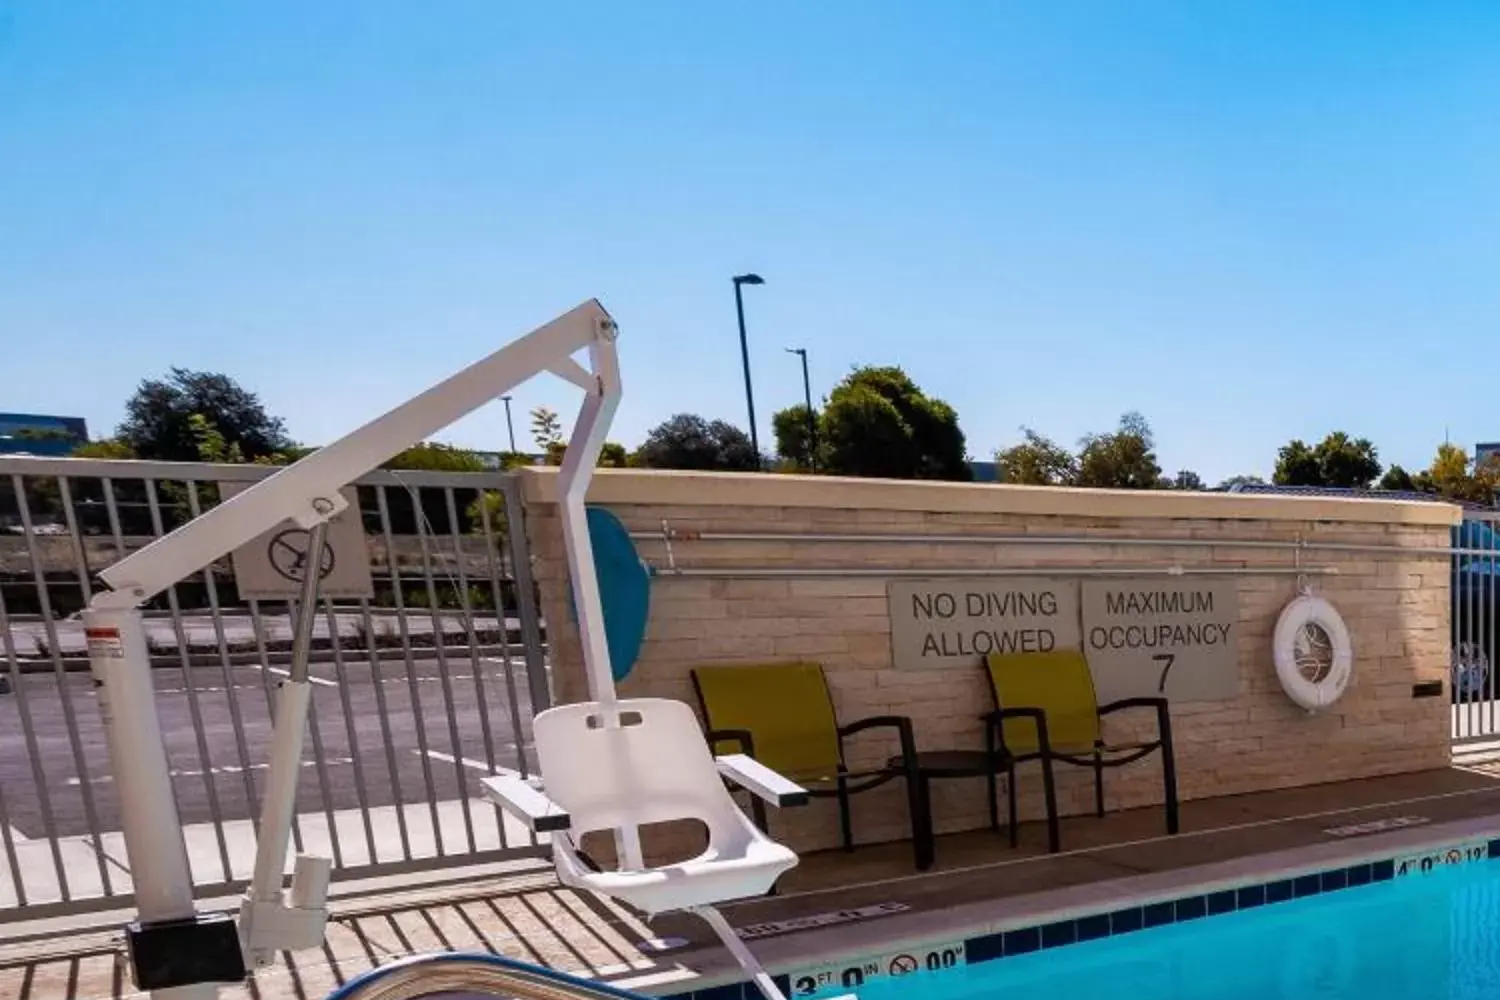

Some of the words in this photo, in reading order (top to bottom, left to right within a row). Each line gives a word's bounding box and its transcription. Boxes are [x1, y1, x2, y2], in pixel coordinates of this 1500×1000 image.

[912, 592, 957, 619] NO
[965, 591, 1058, 617] DIVING
[1105, 591, 1214, 615] MAXIMUM
[921, 629, 1055, 657] ALLOWED
[1089, 622, 1231, 650] OCCUPANCY
[1152, 653, 1175, 692] 7
